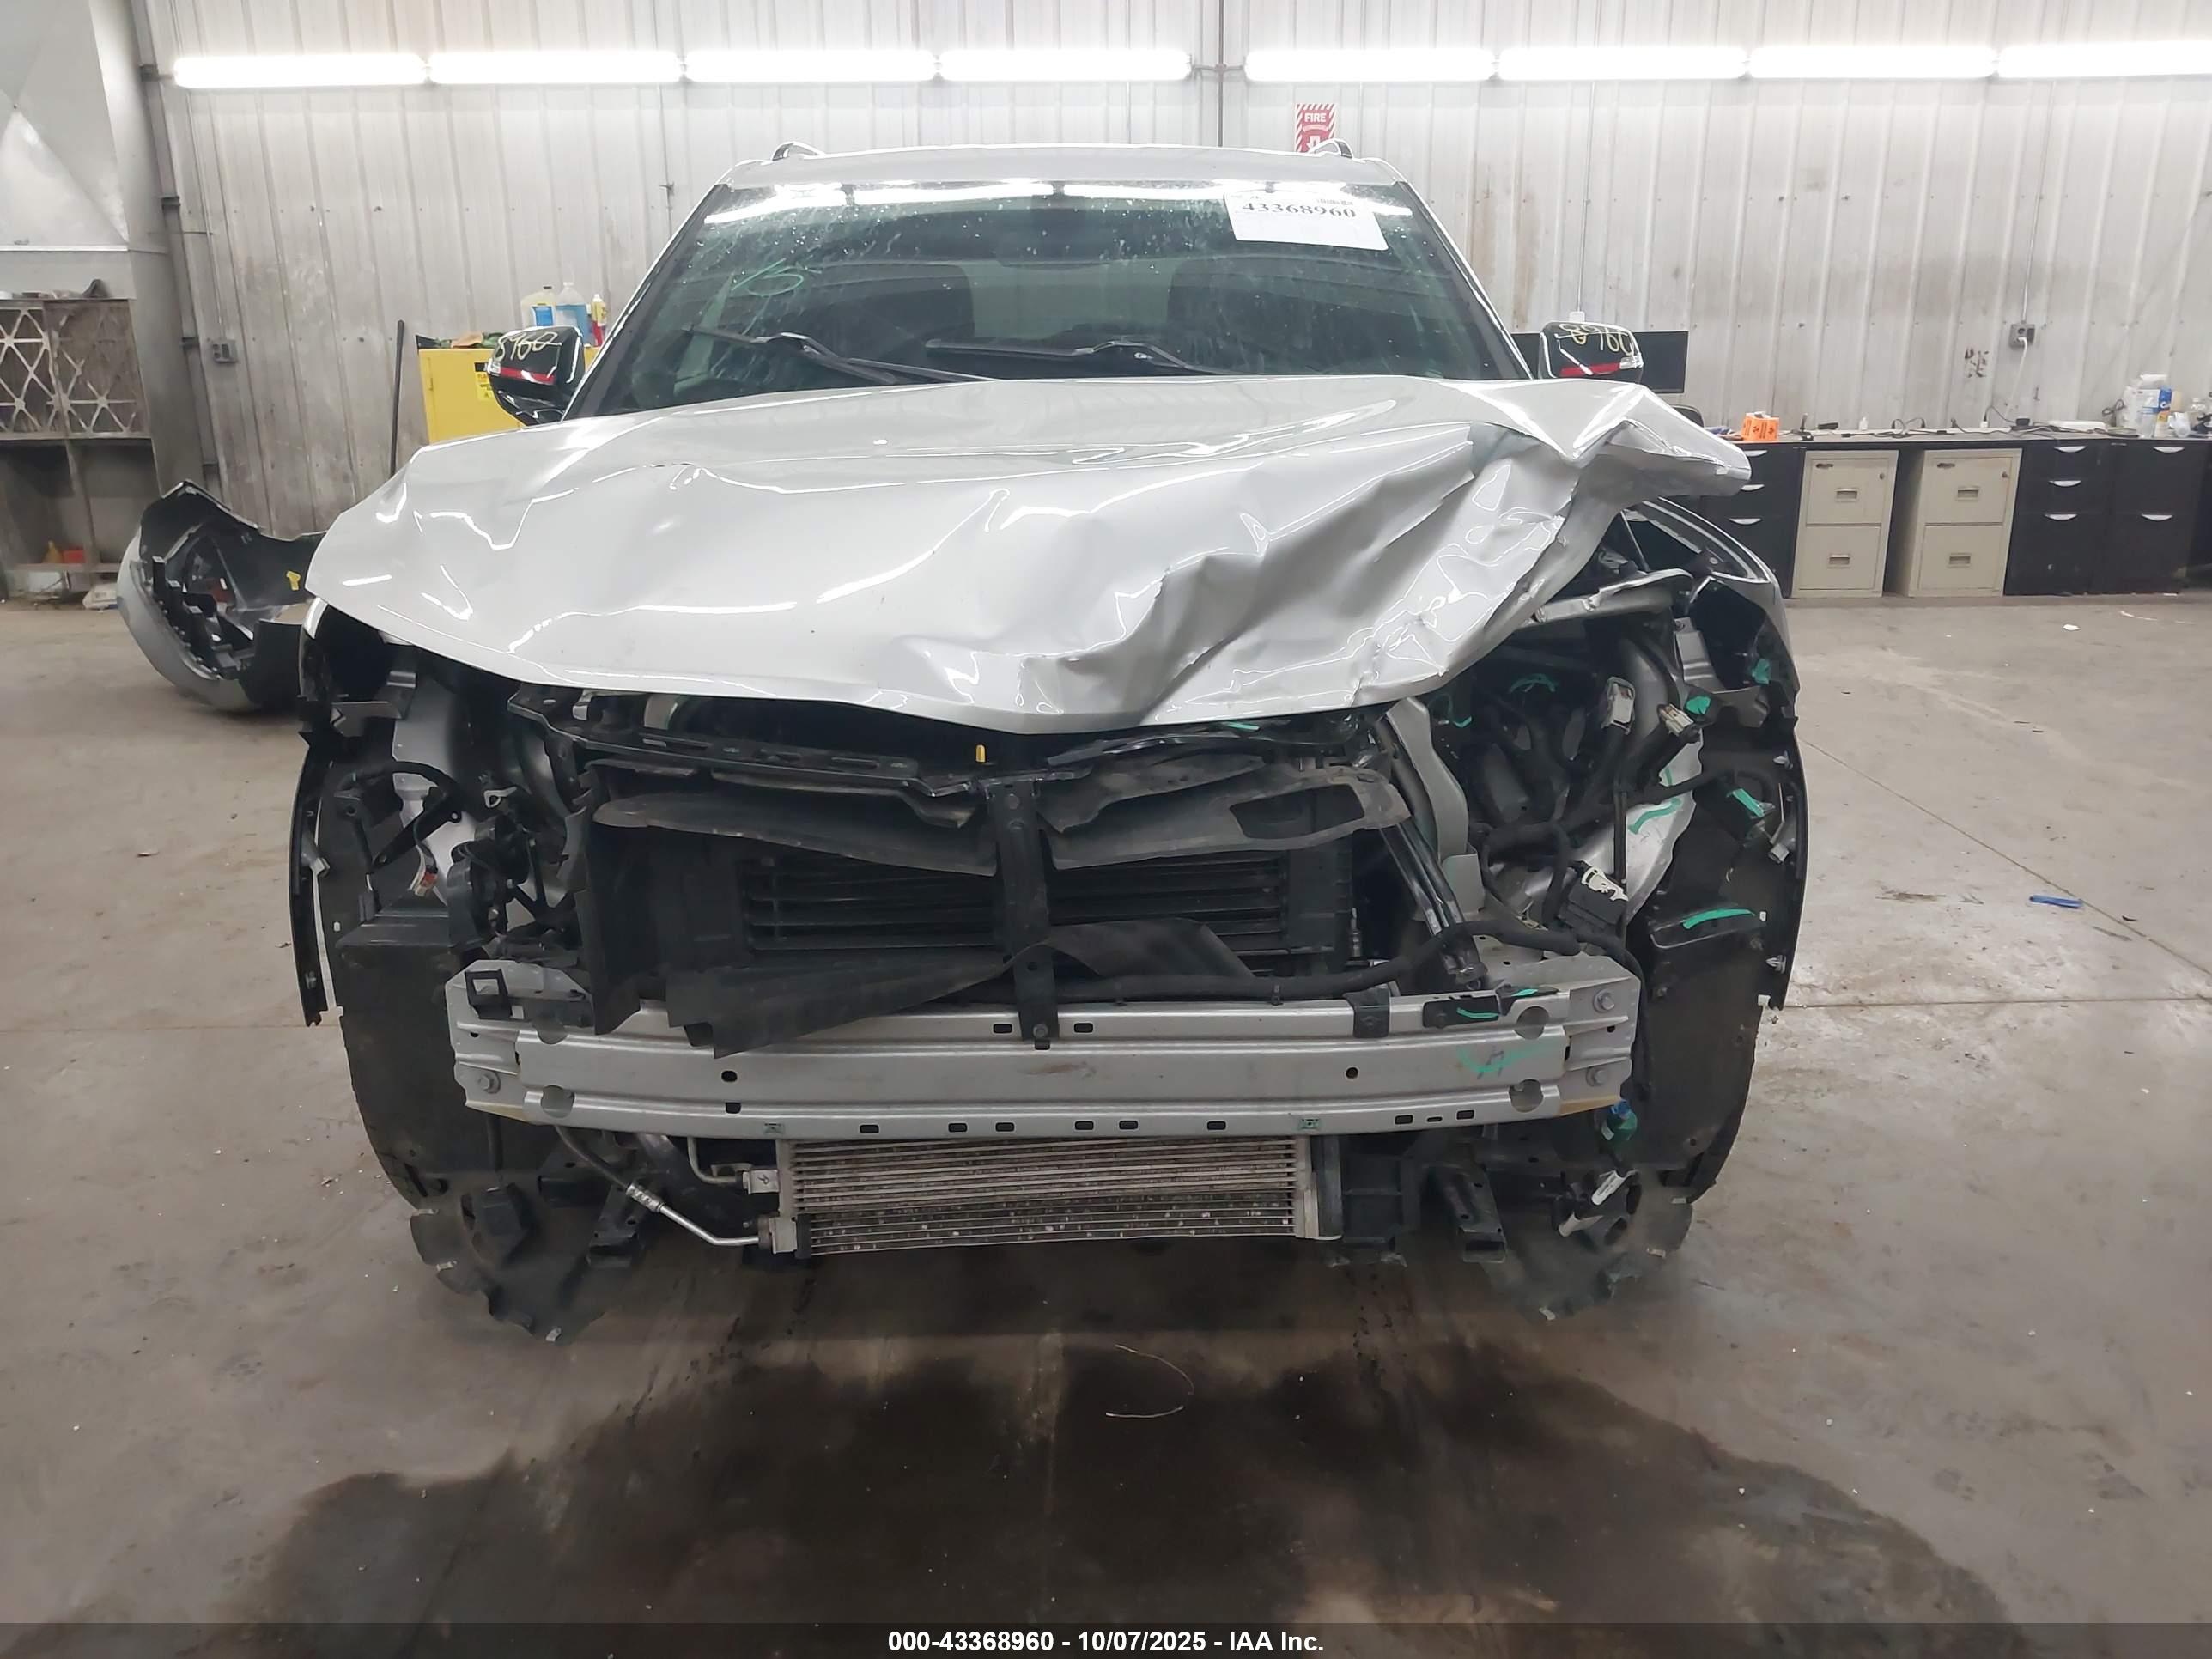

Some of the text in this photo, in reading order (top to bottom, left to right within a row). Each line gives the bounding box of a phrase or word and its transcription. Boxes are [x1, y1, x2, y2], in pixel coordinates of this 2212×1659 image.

[1304, 112, 1327, 123] FIRE
[1243, 202, 1357, 218] 43368960
[495, 331, 559, 362] 8960
[1559, 323, 1635, 357] 8960
